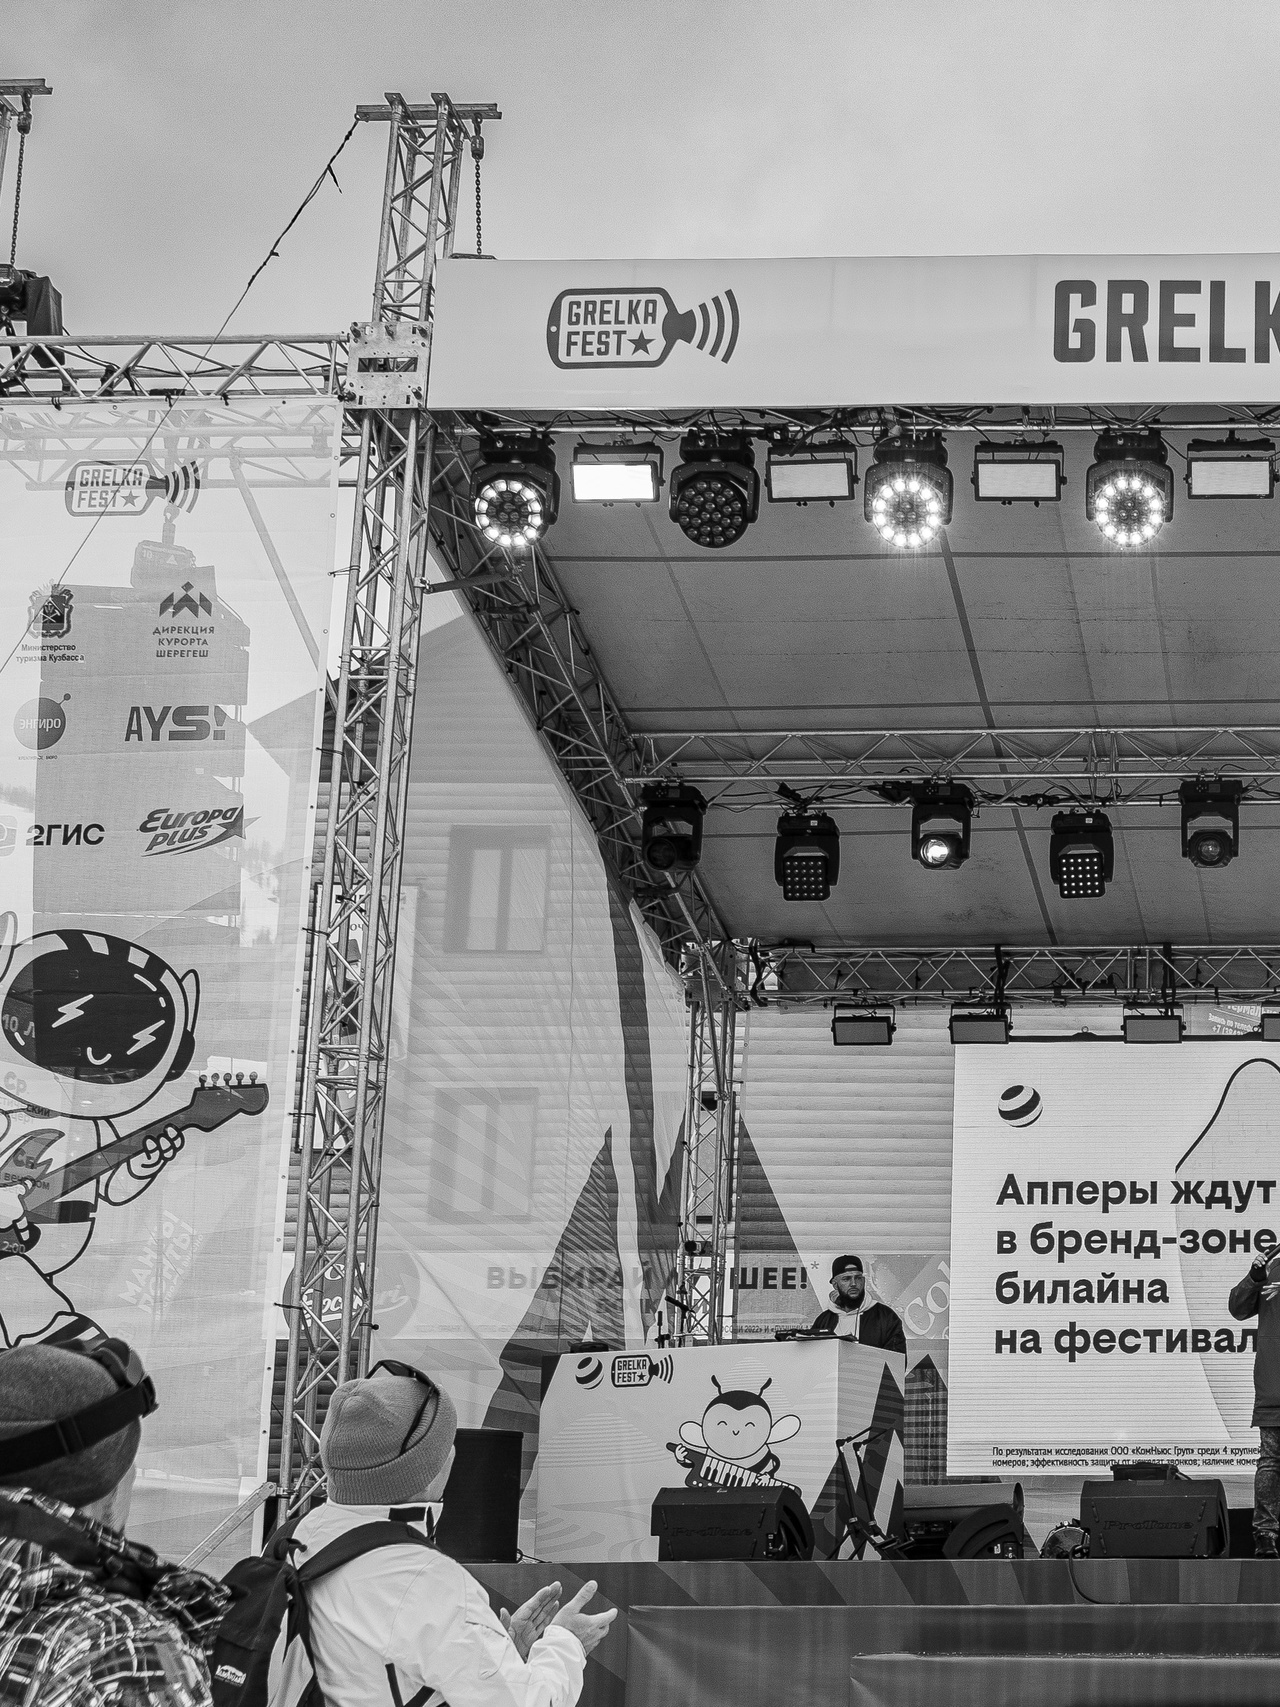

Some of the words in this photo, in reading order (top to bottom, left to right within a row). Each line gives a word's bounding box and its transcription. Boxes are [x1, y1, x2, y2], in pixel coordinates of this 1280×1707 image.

[567, 299, 658, 326] GRELKA
[565, 330, 627, 357] FEST
[79, 468, 144, 488] GRELKA
[77, 490, 121, 508] FEST
[152, 626, 215, 636] ДИРЕКЦИЯ
[20, 643, 77, 653] Министерство
[157, 637, 209, 646] КУРОРТА
[155, 649, 209, 658] ШЕРЕГЕШ
[124, 705, 227, 741] AYS!
[26, 823, 105, 846] 2ГИС
[995, 1173, 1158, 1213] Апперы
[1170, 1180, 1277, 1213] ждут
[996, 1229, 1017, 1254] в
[1030, 1221, 1278, 1263] бренд-зоне
[995, 1270, 1170, 1305] билайна
[995, 1330, 1043, 1355] на
[1053, 1322, 1258, 1362] фестивал
[617, 1359, 647, 1371] GRELKA
[617, 1372, 637, 1383] FEST
[992, 1447, 1003, 1456] По
[1005, 1447, 1052, 1459] результатам
[1055, 1447, 1109, 1458] исследования
[1110, 1446, 1129, 1456] ООО
[1197, 1447, 1221, 1457] среди
[1222, 1446, 1228, 1455] 4
[1230, 1446, 1261, 1458] крупней
[992, 1459, 1029, 1468] номеров;
[1030, 1458, 1089, 1469] эффективность
[1202, 1458, 1235, 1467] наличие
[1237, 1458, 1257, 1467] номе
[1103, 1520, 1194, 1530] ProTone
